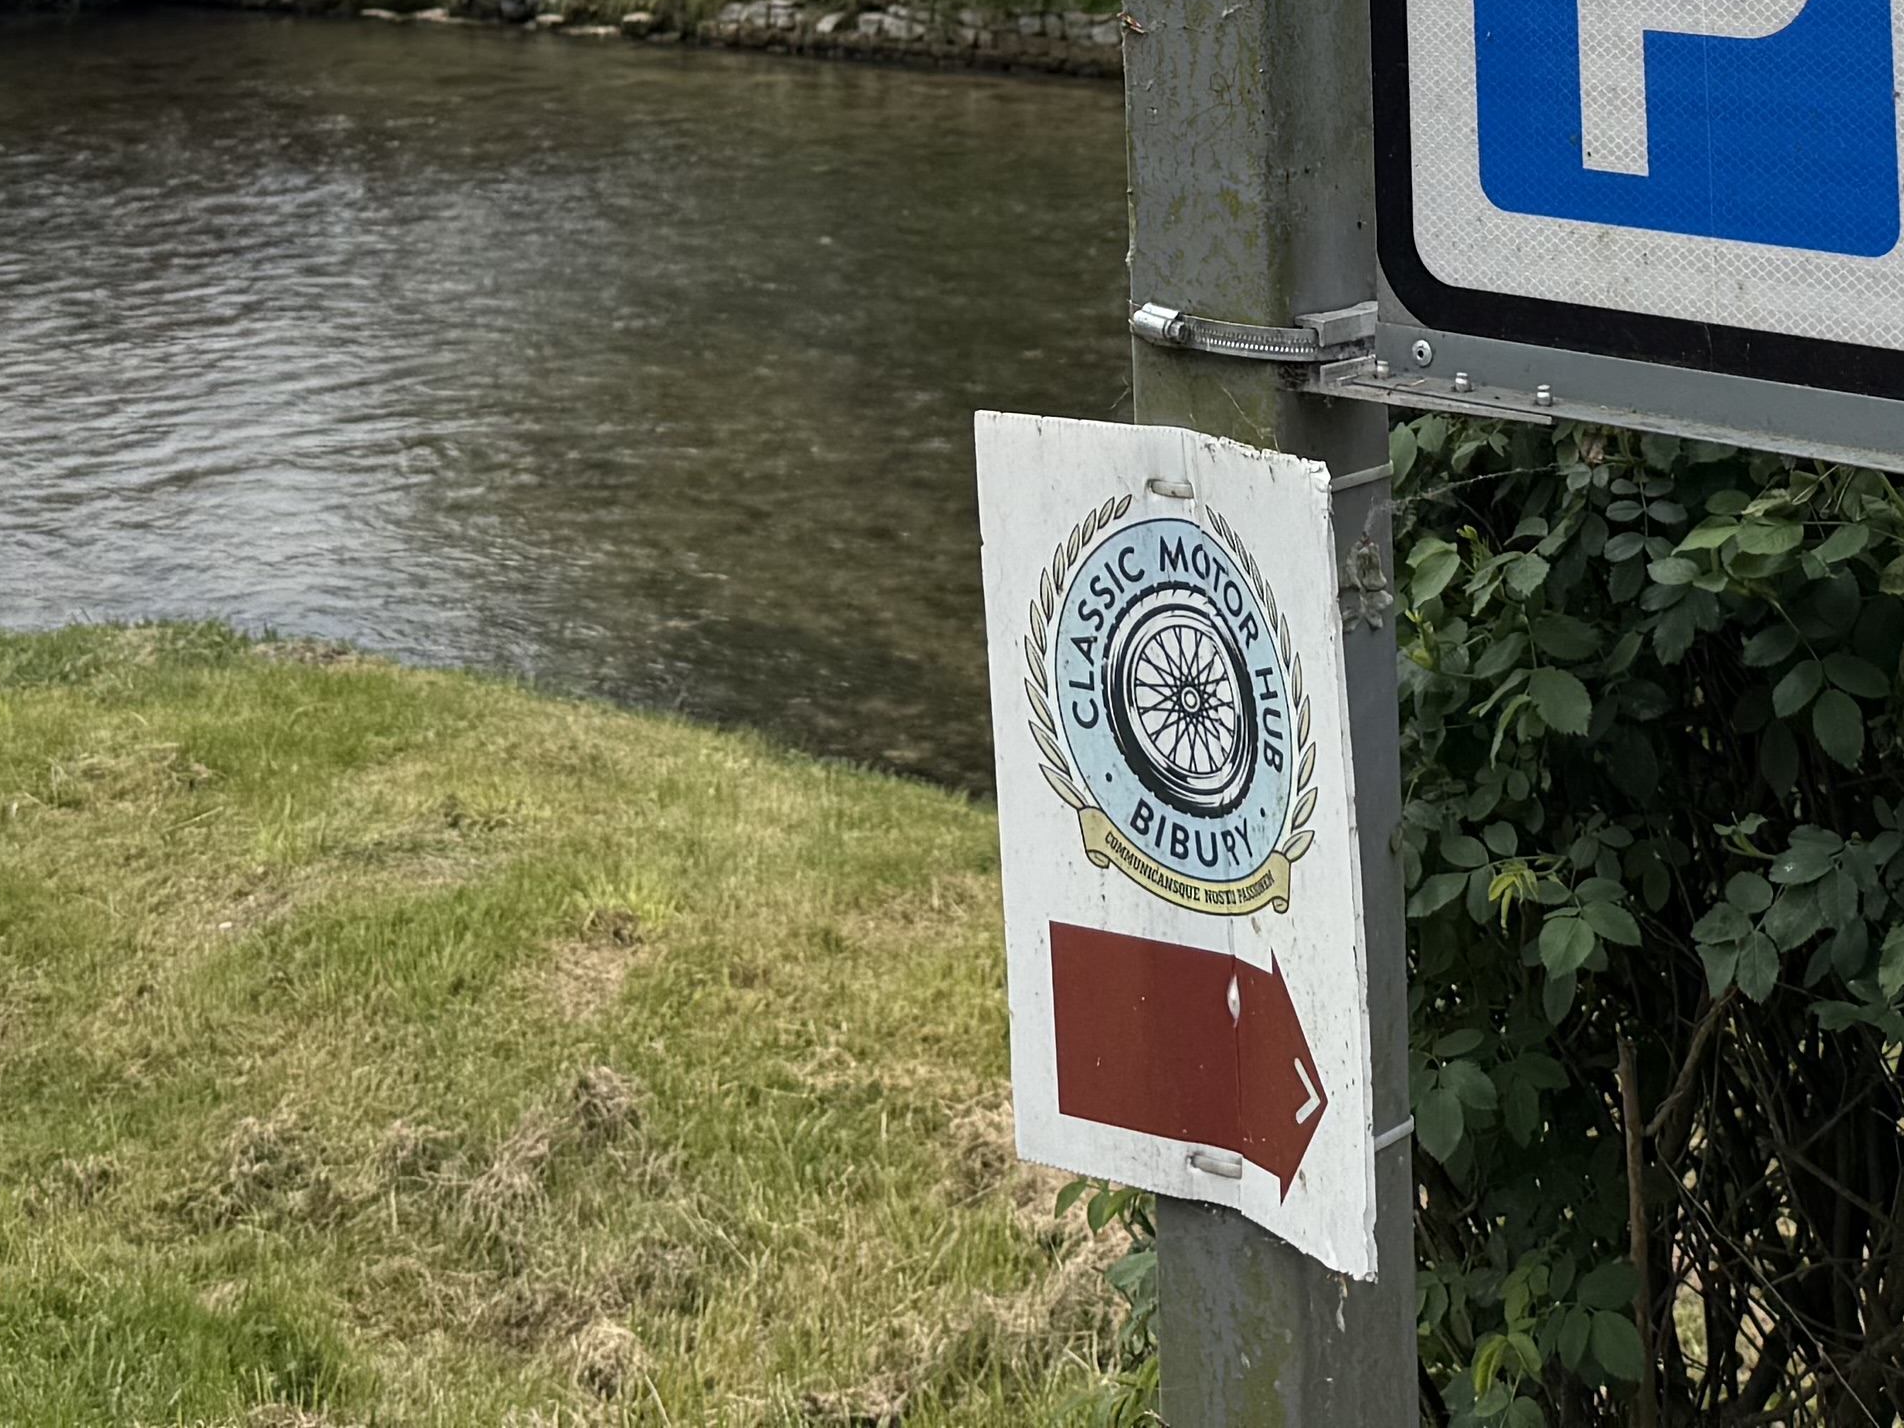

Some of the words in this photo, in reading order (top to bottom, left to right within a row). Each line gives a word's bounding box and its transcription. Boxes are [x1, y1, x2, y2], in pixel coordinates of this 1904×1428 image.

[1068, 545, 1145, 730] CLASSIC
[1158, 534, 1259, 651] MOTOR
[1254, 666, 1284, 774] HUB
[1129, 797, 1253, 868] BIBURY
